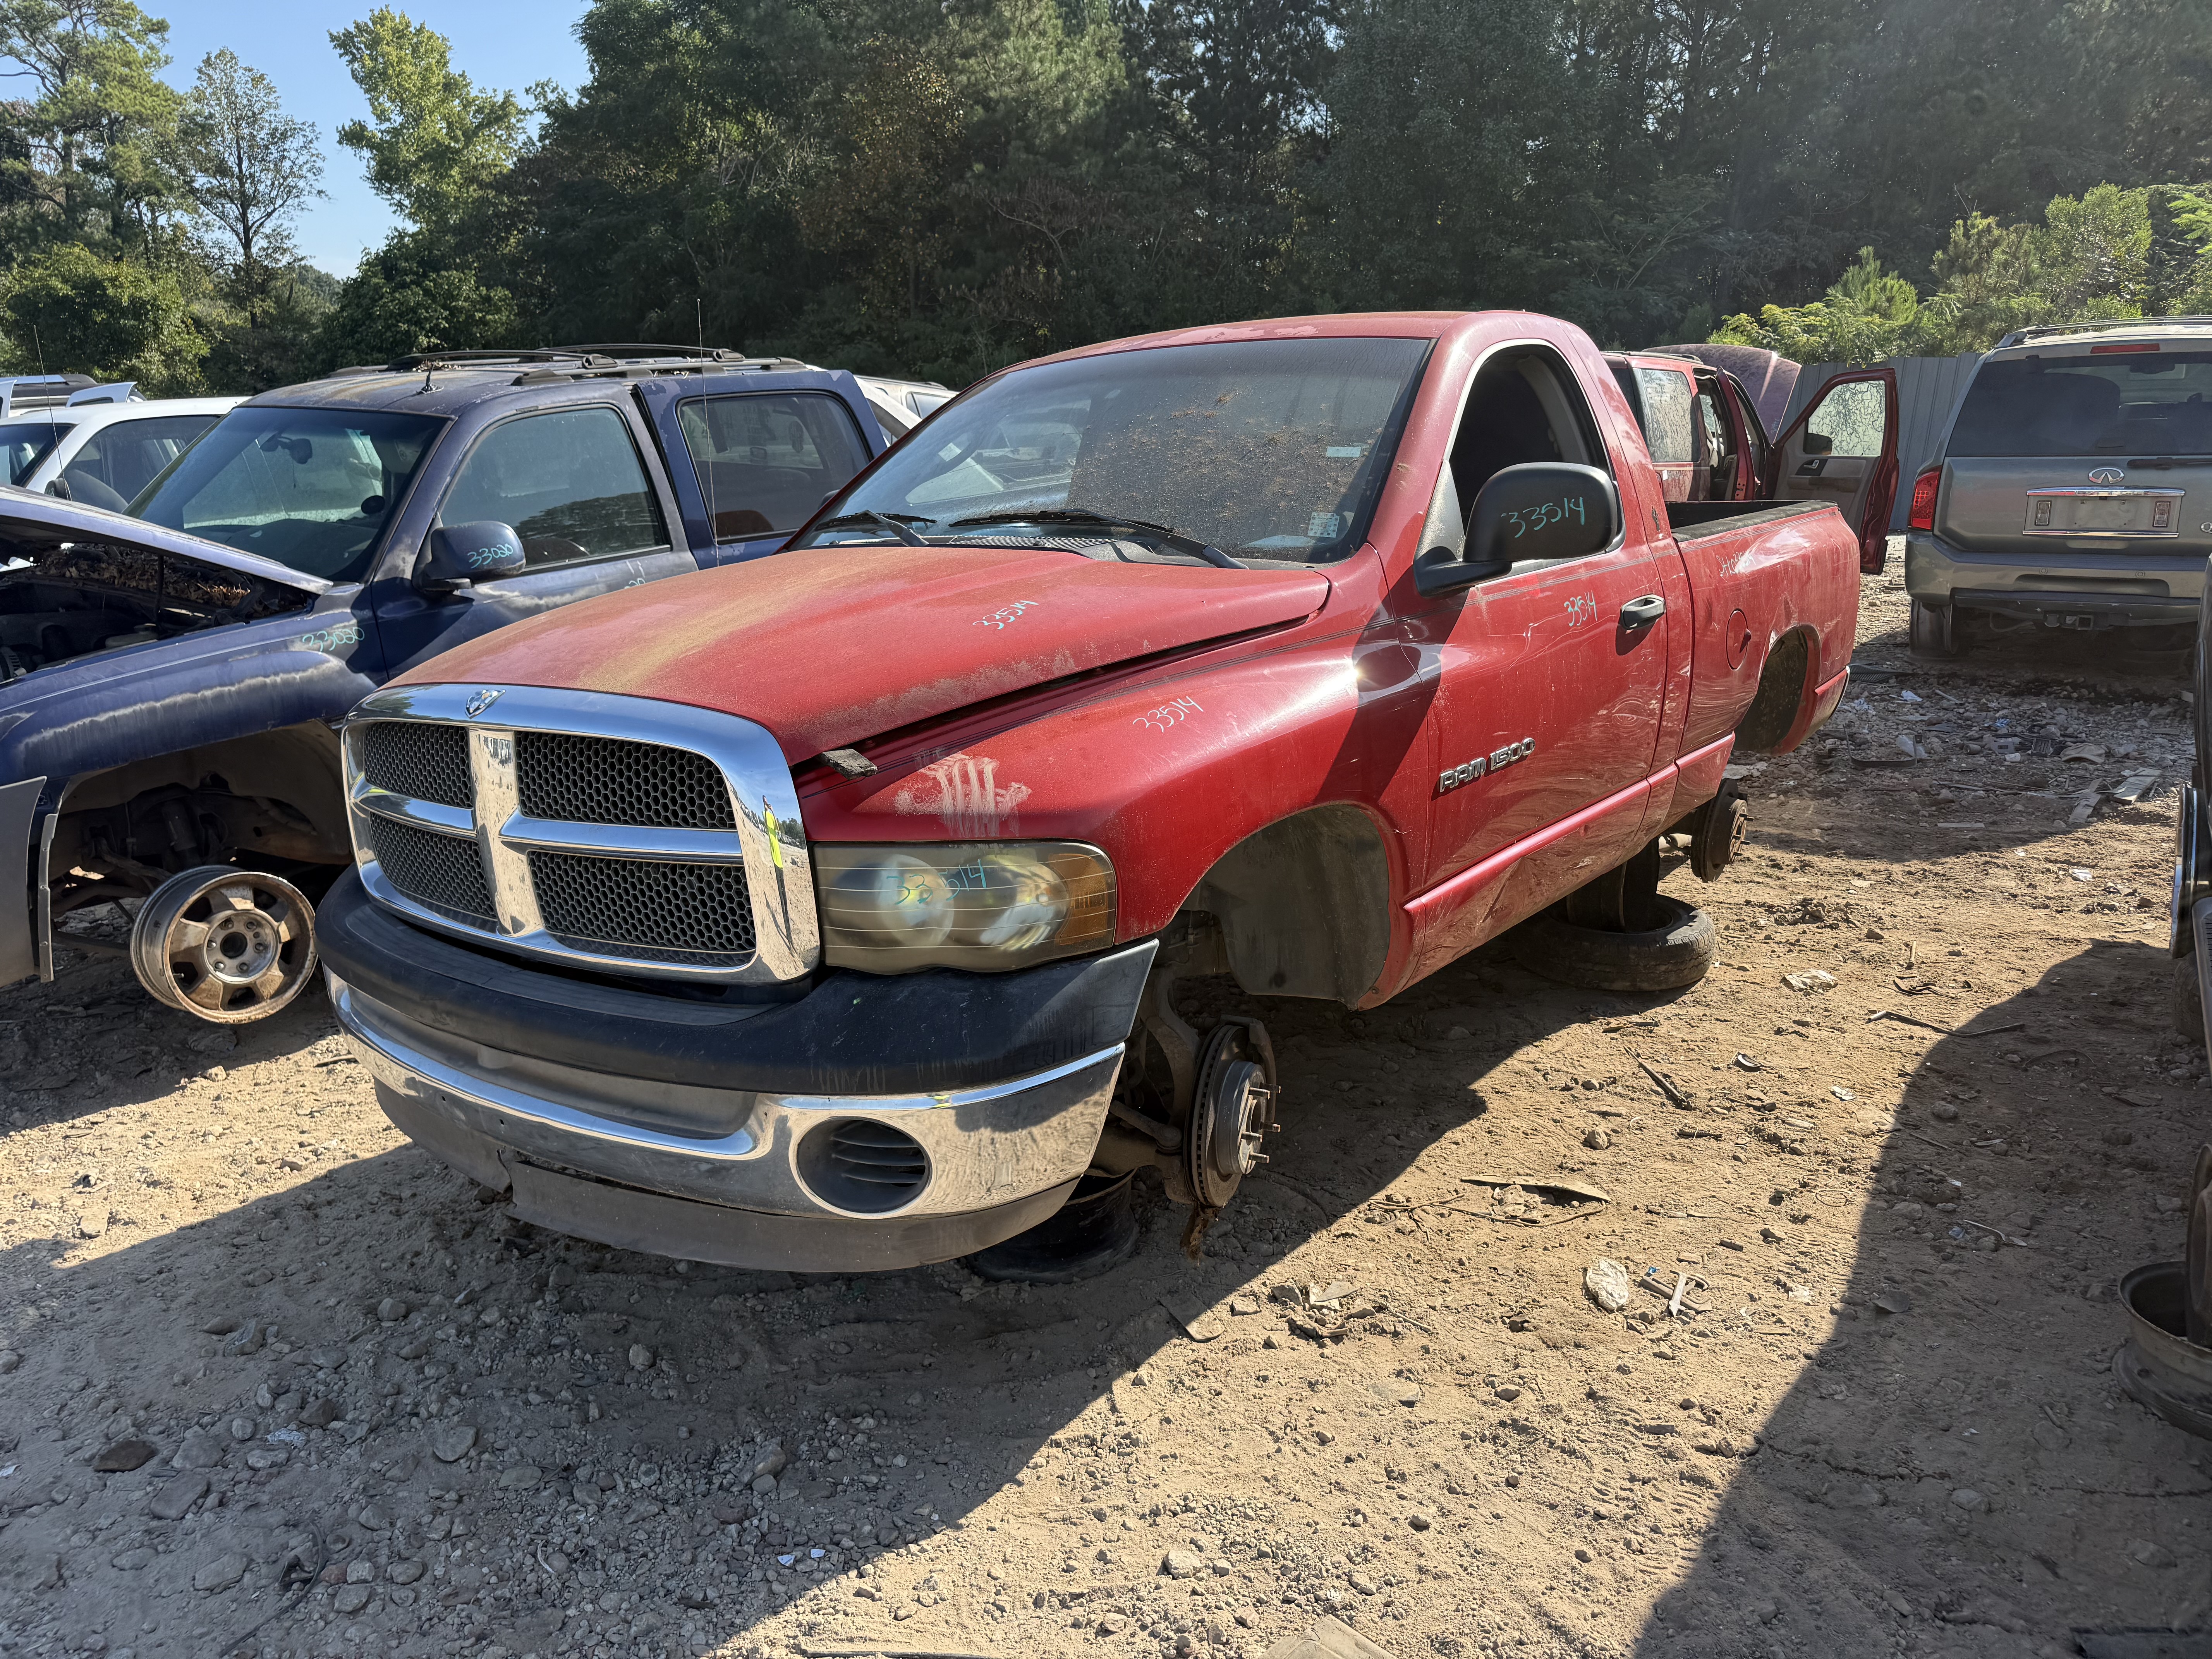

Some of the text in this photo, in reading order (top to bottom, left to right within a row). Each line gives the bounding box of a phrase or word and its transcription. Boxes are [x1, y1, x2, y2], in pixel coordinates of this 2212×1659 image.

[1501, 497, 1585, 538] 33514
[467, 543, 513, 569] 33020
[302, 627, 365, 655] 33020
[1133, 696, 1204, 733] 33514
[1439, 737, 1535, 793] RAM 1500
